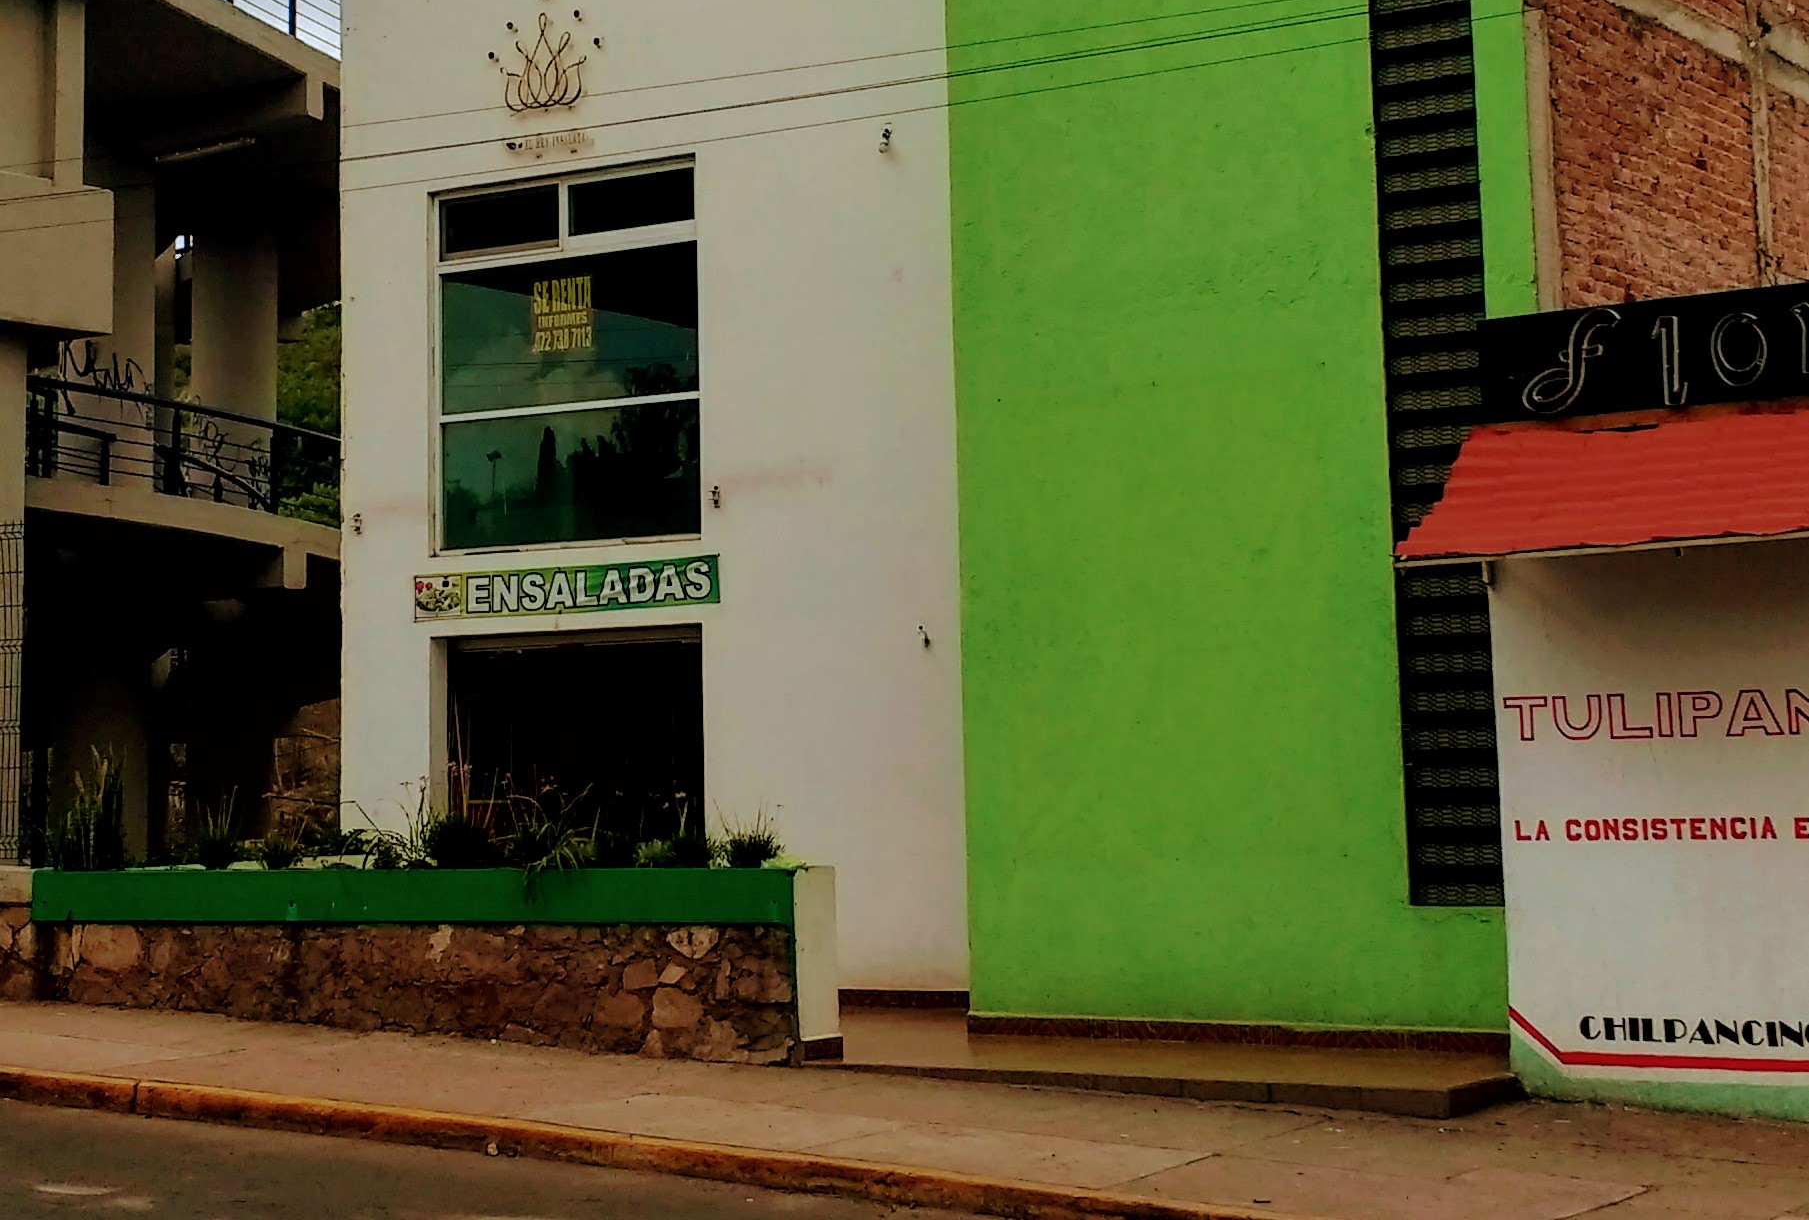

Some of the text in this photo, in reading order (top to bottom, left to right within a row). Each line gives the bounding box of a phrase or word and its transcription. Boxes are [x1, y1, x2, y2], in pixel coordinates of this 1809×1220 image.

[533, 275, 592, 314] SE RENTA
[537, 311, 588, 328] INFORMES
[465, 560, 713, 614] ENSALADAS
[1513, 817, 1551, 842] LA
[1565, 816, 1778, 842] CONSISTENCIA
[1579, 1015, 1809, 1049] CHILPANCIN
